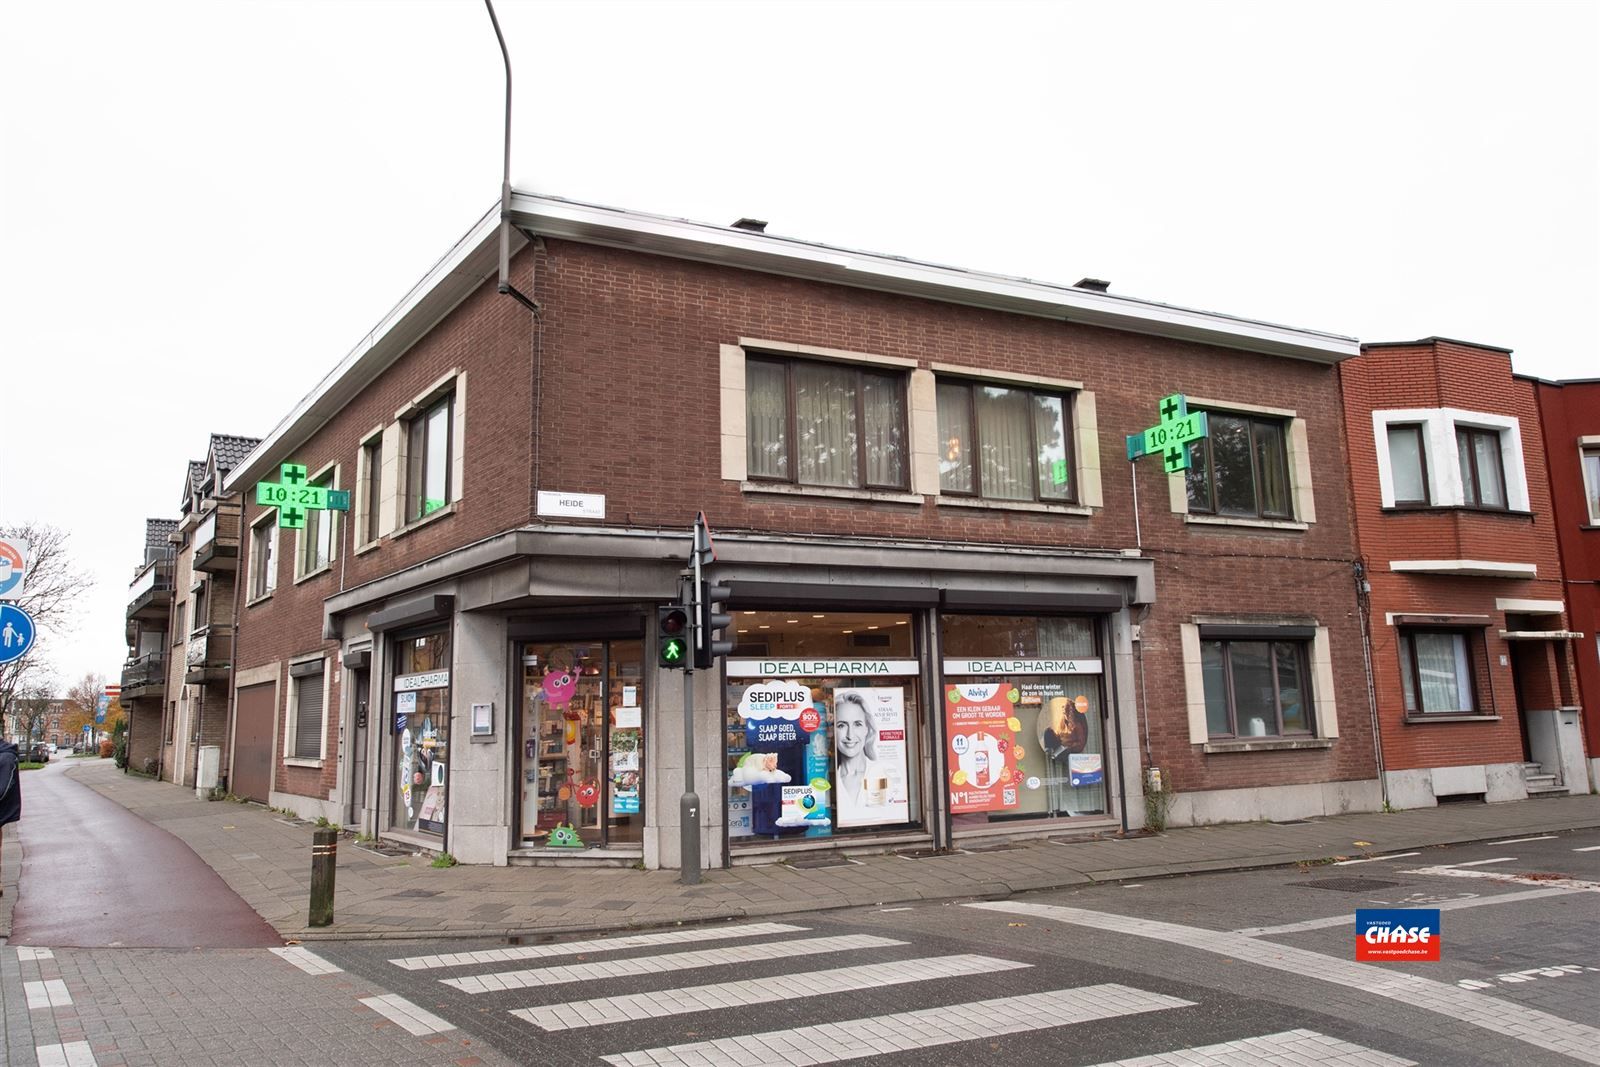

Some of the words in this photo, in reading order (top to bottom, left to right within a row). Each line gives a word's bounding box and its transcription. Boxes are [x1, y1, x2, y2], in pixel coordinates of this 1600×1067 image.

[1150, 419, 1195, 448] 10:21
[265, 486, 321, 505] 10:21
[559, 499, 584, 508] HEIDE
[759, 662, 889, 674] IDEALPHARMA
[967, 661, 1077, 673] IDEALPHARMA
[403, 671, 448, 689] IDEALPHARMA
[749, 691, 805, 703] SEDIPLUS
[968, 688, 988, 698] Alvityl
[758, 724, 778, 733] SLAAP
[758, 733, 778, 742] SLAAP
[778, 732, 797, 741] BETER
